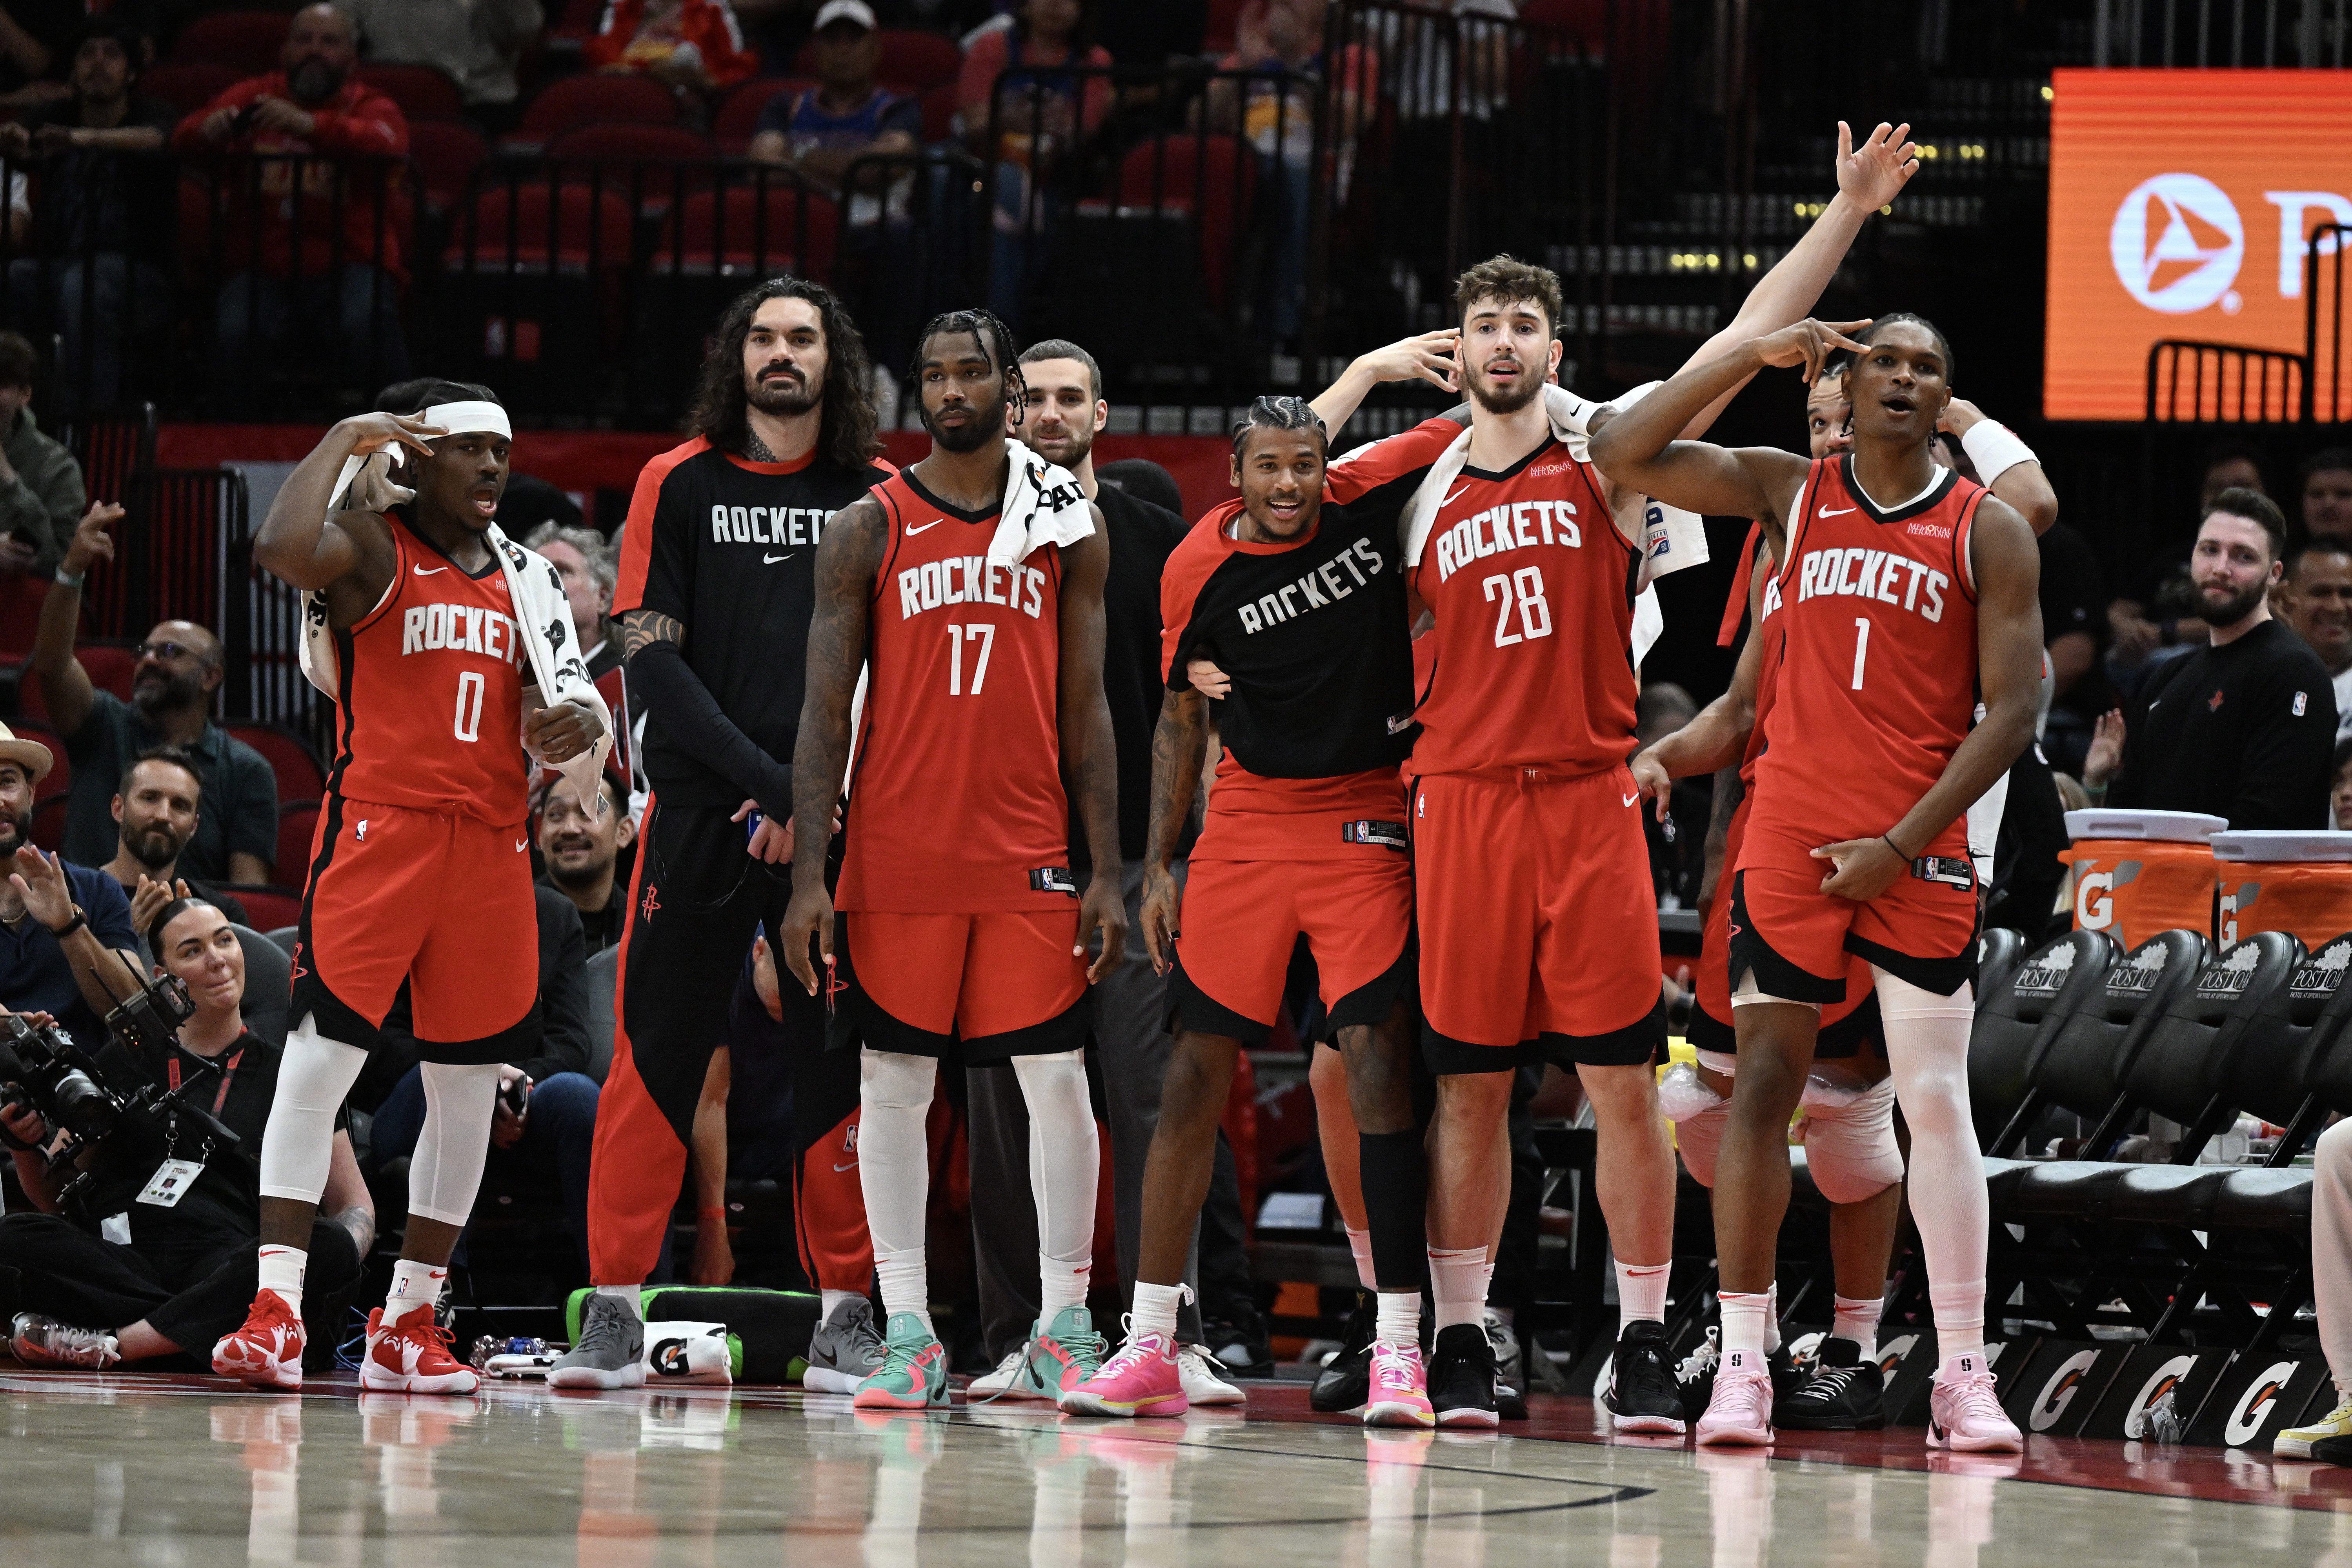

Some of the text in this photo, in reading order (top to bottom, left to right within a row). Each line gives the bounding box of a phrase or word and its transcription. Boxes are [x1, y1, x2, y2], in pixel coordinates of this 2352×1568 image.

[1531, 461, 1571, 472] MEMORIAL
[1531, 465, 1571, 477] HERMANN
[1436, 500, 1582, 584] ROCKETS
[1907, 527, 1951, 538] HERMANN
[1908, 522, 1951, 534] MEMORIAL
[898, 556, 1046, 620] ROCKETS
[1483, 566, 1552, 648] 28
[1798, 548, 1948, 623] ROCKETS
[948, 624, 995, 695] 17
[1852, 617, 1870, 690] 1
[455, 671, 485, 742] 0
[2077, 871, 2113, 931] G
[2015, 969, 2051, 986] POST
[2108, 968, 2142, 987] POST
[2199, 971, 2234, 988] POST
[2292, 970, 2326, 988] POST
[650, 1338, 690, 1375] G
[2029, 1349, 2101, 1432] G
[2225, 1361, 2300, 1446] G
